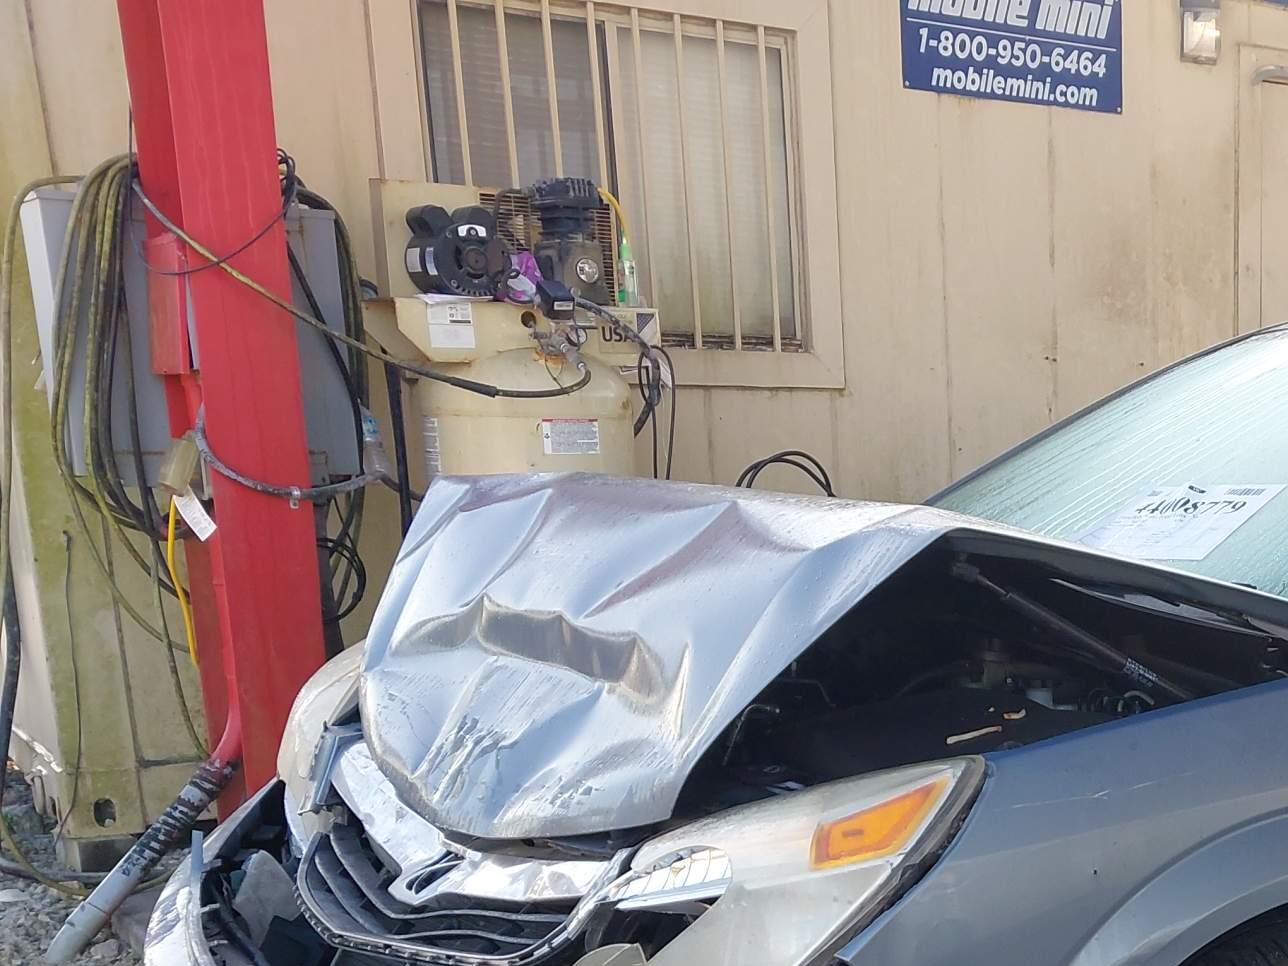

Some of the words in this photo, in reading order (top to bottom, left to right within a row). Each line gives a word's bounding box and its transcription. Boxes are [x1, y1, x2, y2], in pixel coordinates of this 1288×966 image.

[1035, 0, 1113, 39] mini
[919, 27, 1106, 78] 1-800-950-6464
[931, 67, 1098, 106] mobilemini.com
[601, 326, 633, 342] US
